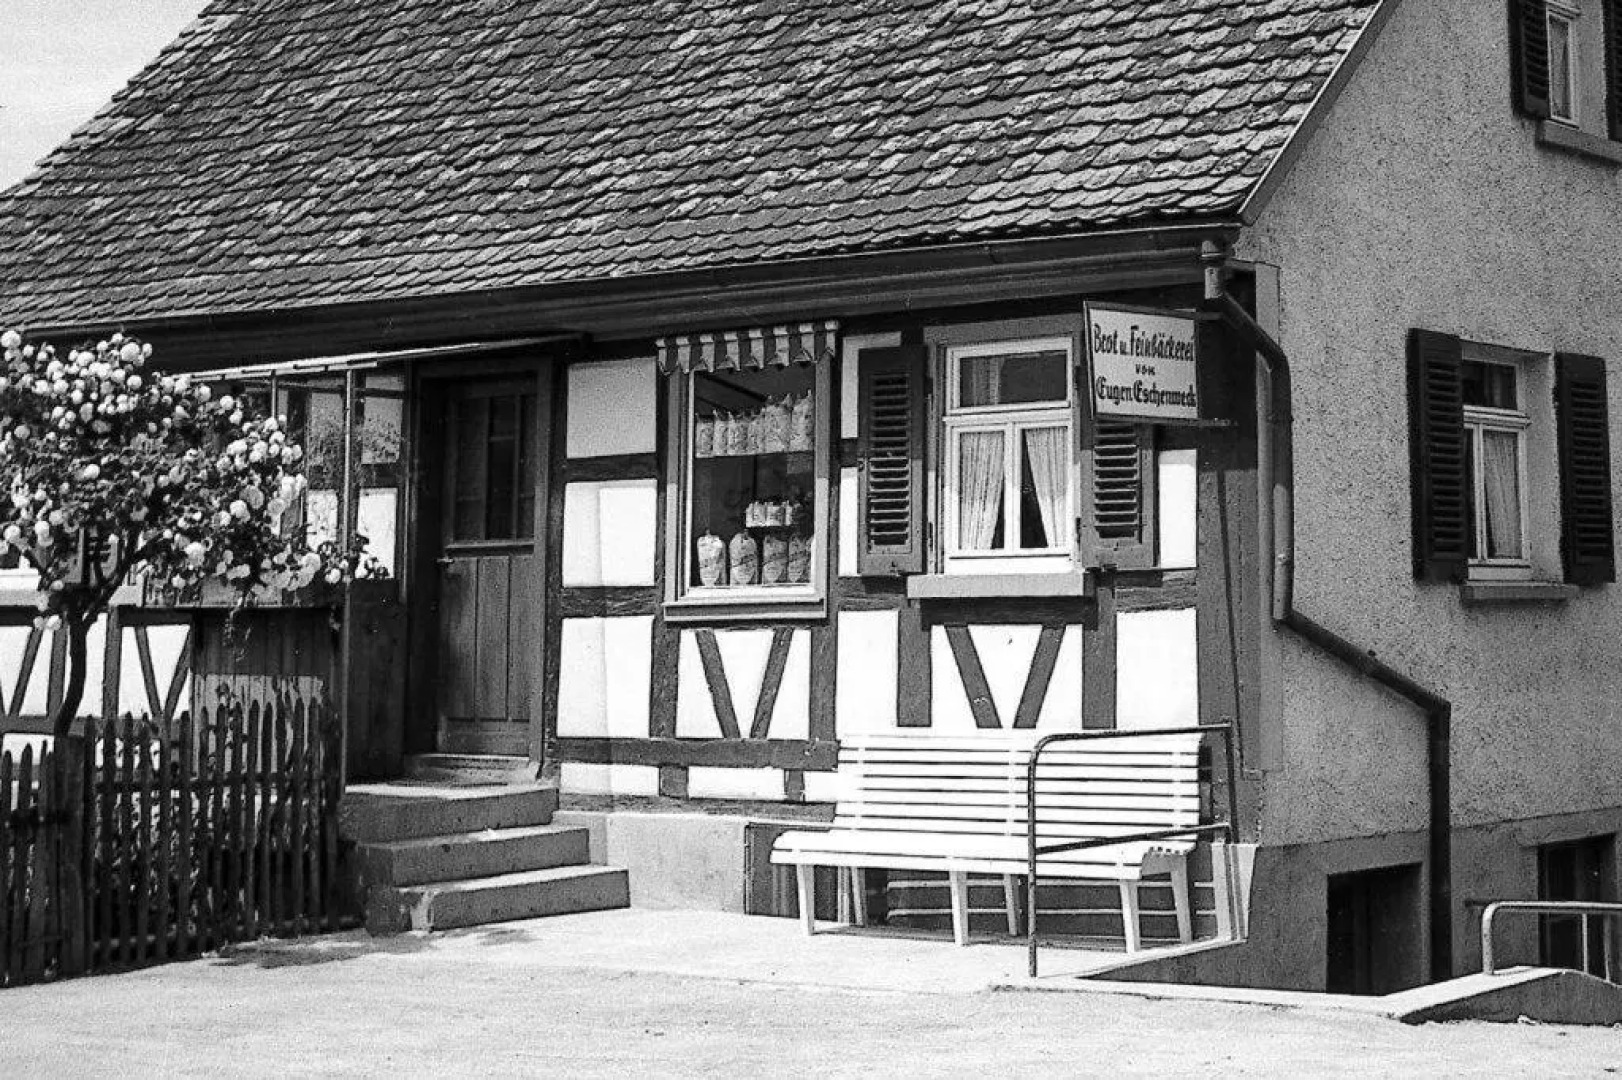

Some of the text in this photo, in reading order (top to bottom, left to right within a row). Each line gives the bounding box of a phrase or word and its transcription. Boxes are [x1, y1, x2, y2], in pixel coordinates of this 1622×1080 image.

[1094, 323, 1118, 354] Brot
[1131, 325, 1195, 361] Feinbäckerei
[1135, 363, 1156, 375] von
[1096, 376, 1133, 406] Eugen
